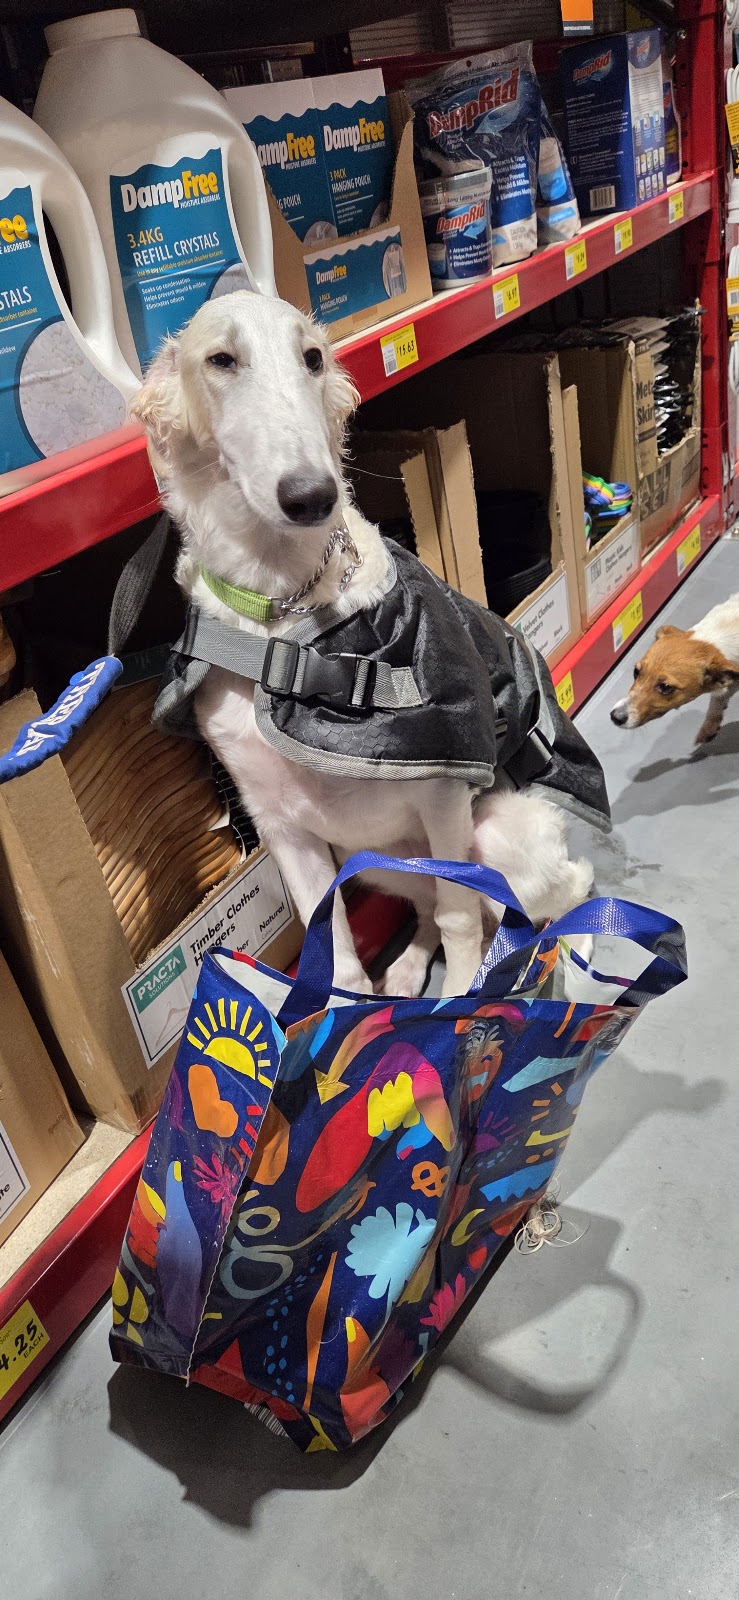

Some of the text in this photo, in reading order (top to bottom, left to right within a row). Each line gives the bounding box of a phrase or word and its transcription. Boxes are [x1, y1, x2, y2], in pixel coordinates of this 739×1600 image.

[429, 66, 520, 139] DampRid
[323, 118, 385, 152] DampFree
[331, 174, 371, 194] HANGING POUCH
[333, 168, 347, 180] PACK
[121, 170, 218, 213] DampFree
[283, 194, 302, 209] POUCH
[436, 198, 486, 234] DampRid
[127, 227, 164, 249] 3.4KG
[133, 232, 220, 268] REFILL CRYSTALS
[141, 285, 156, 295] Soaks
[316, 265, 347, 285] DampFree
[143, 294, 158, 303] Helps
[157, 290, 175, 299] prevent
[537, 600, 555, 619] Clothes
[190, 884, 260, 954] Timber Clothes
[236, 901, 285, 953] ber Natural
[194, 923, 236, 967] Hgers
[137, 955, 181, 1001] PRACTA
[148, 971, 176, 999] SOLUTIONS
[0, 1318, 38, 1371] 4.25
[23, 1332, 44, 1359] EACH
